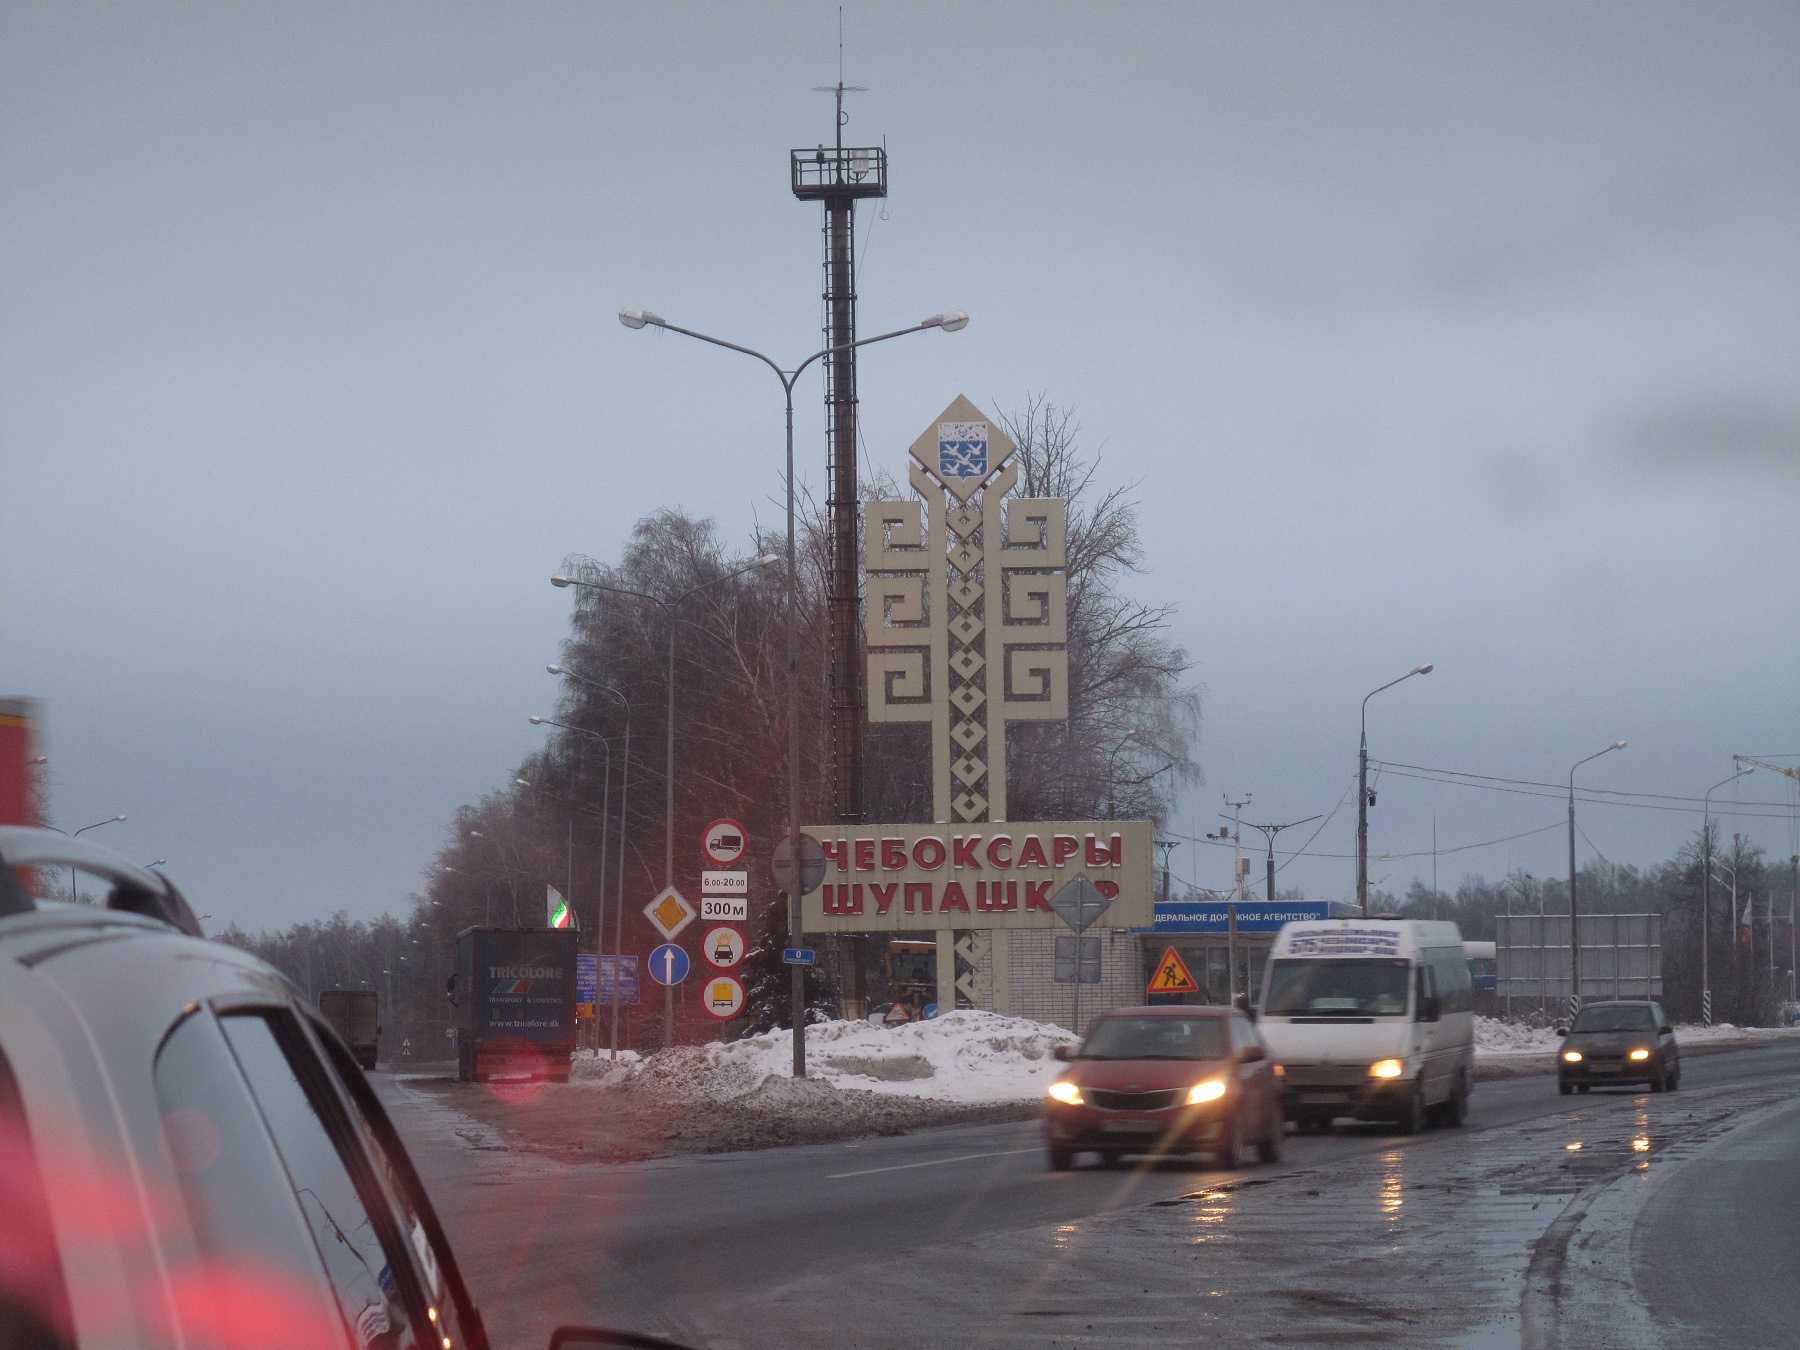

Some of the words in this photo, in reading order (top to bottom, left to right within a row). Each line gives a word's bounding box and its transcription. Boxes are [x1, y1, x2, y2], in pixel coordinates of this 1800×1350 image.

[822, 832, 1121, 872] ЧЕБОКСАРЫ
[704, 878, 745, 886] 6.00-20.00
[823, 879, 1120, 915] ШУПАШКР
[704, 902, 731, 915] 300
[1210, 913, 1261, 922] ДОРЖНОЕ
[796, 950, 802, 959] 0
[489, 966, 563, 979] TRICOLORE
[489, 1020, 560, 1028] www.tricolore.dk
